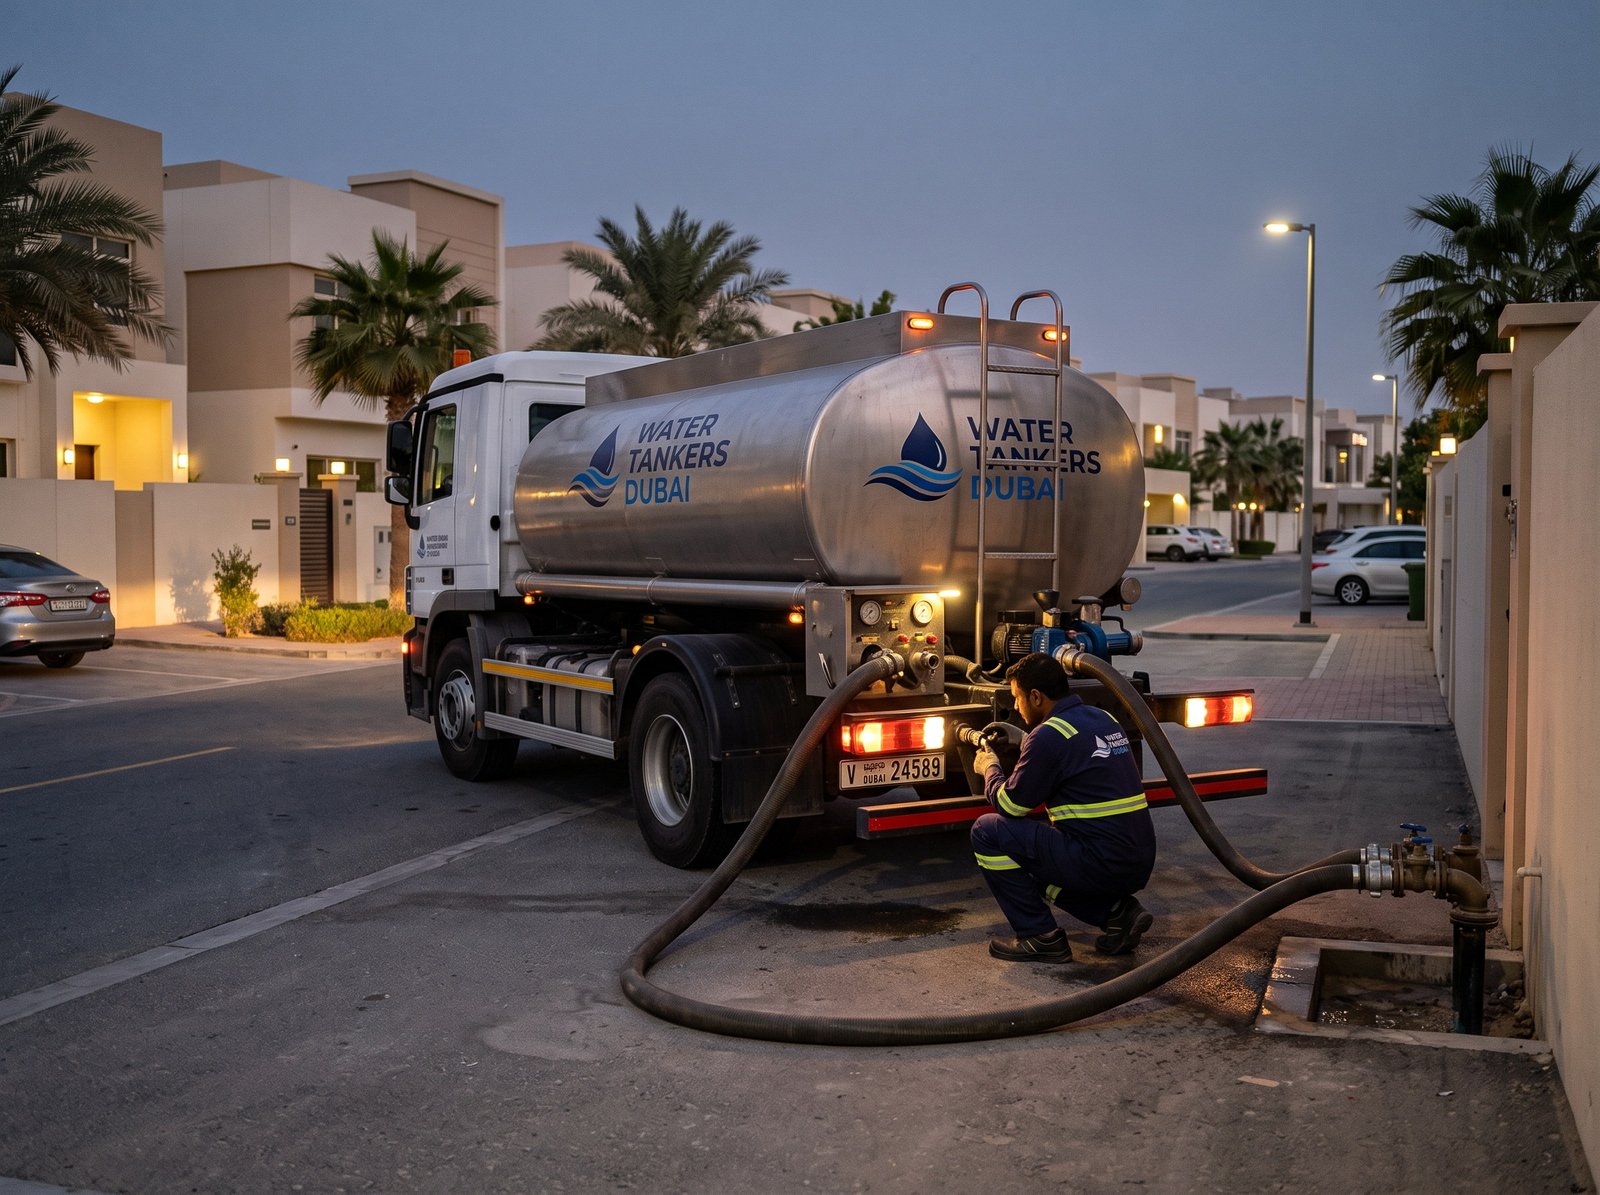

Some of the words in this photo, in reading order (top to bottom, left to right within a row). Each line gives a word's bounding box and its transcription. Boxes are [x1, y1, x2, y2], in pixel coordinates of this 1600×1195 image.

[638, 413, 719, 444] WATER
[967, 416, 1073, 444] WATER
[629, 439, 731, 473] TANKERS
[625, 475, 690, 505] DUBAI
[972, 474, 1064, 501] DUBAI
[847, 764, 856, 784] V
[863, 773, 886, 785] DUBAI
[890, 757, 941, 781] 24589
